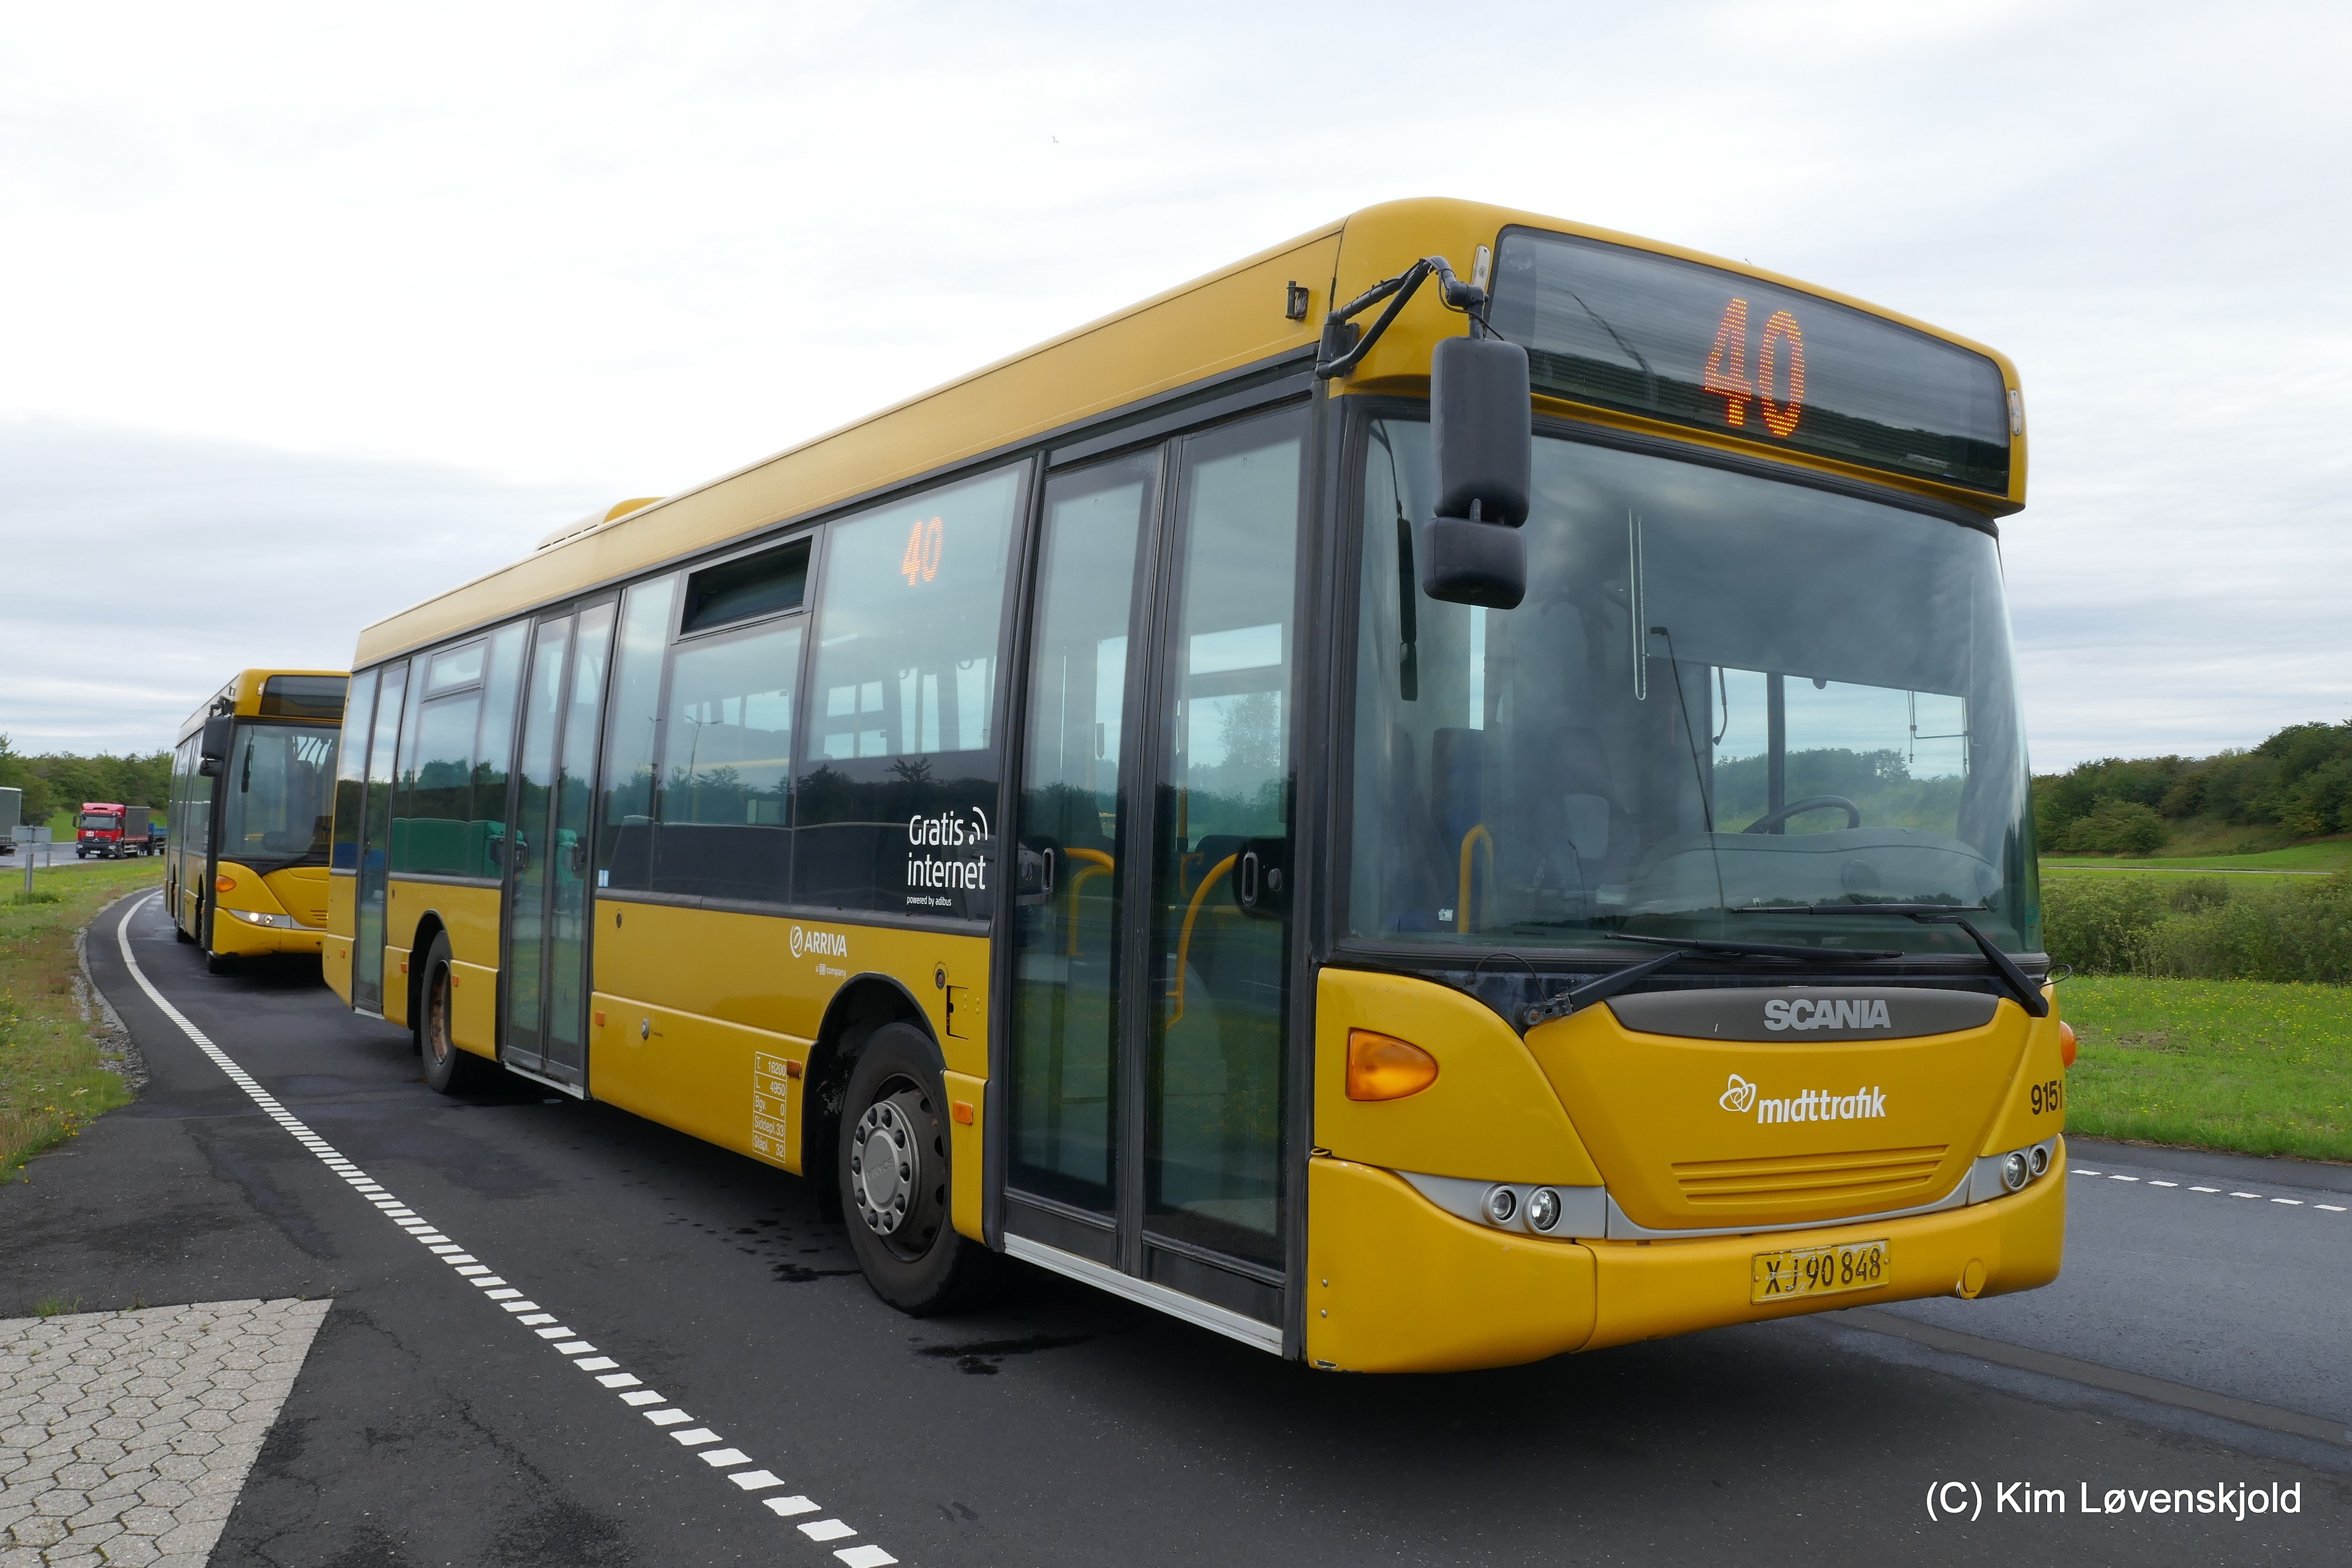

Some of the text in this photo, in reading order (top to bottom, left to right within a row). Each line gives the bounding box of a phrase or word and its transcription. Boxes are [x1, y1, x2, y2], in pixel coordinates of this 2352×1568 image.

[1705, 298, 1806, 437] 40
[902, 517, 942, 586] 40
[909, 811, 964, 846] Gratis
[907, 853, 986, 889] internet
[907, 896, 952, 907] powered by adibus
[804, 930, 847, 957] ARRIVA
[826, 967, 847, 979] company
[1763, 999, 1891, 1031] SCANIA
[768, 1061, 786, 1076] 16200
[770, 1081, 785, 1096] 4950
[2031, 1079, 2062, 1115] 9151
[755, 1095, 785, 1116] Bgv. 0
[1757, 1086, 1887, 1124] midttrafik
[776, 1123, 784, 1137] 33
[775, 1143, 784, 1158] 32
[1765, 1248, 1881, 1294] XJ 90 848
